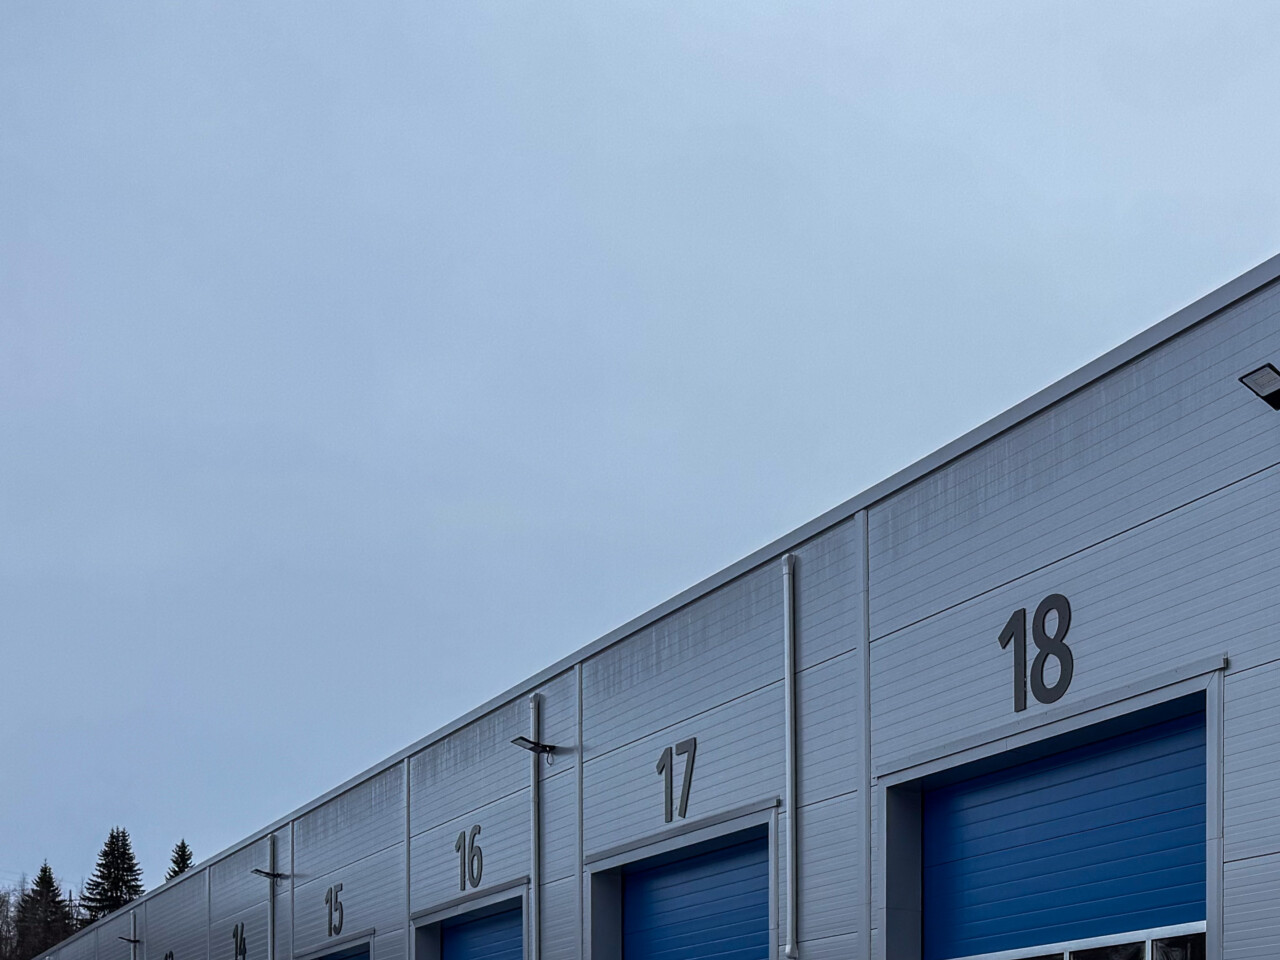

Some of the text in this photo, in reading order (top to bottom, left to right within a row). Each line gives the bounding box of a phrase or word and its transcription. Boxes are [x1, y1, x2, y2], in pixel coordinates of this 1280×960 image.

[998, 593, 1073, 713] 18
[656, 737, 697, 823] 17
[455, 825, 483, 891] 16
[325, 883, 343, 937] 15
